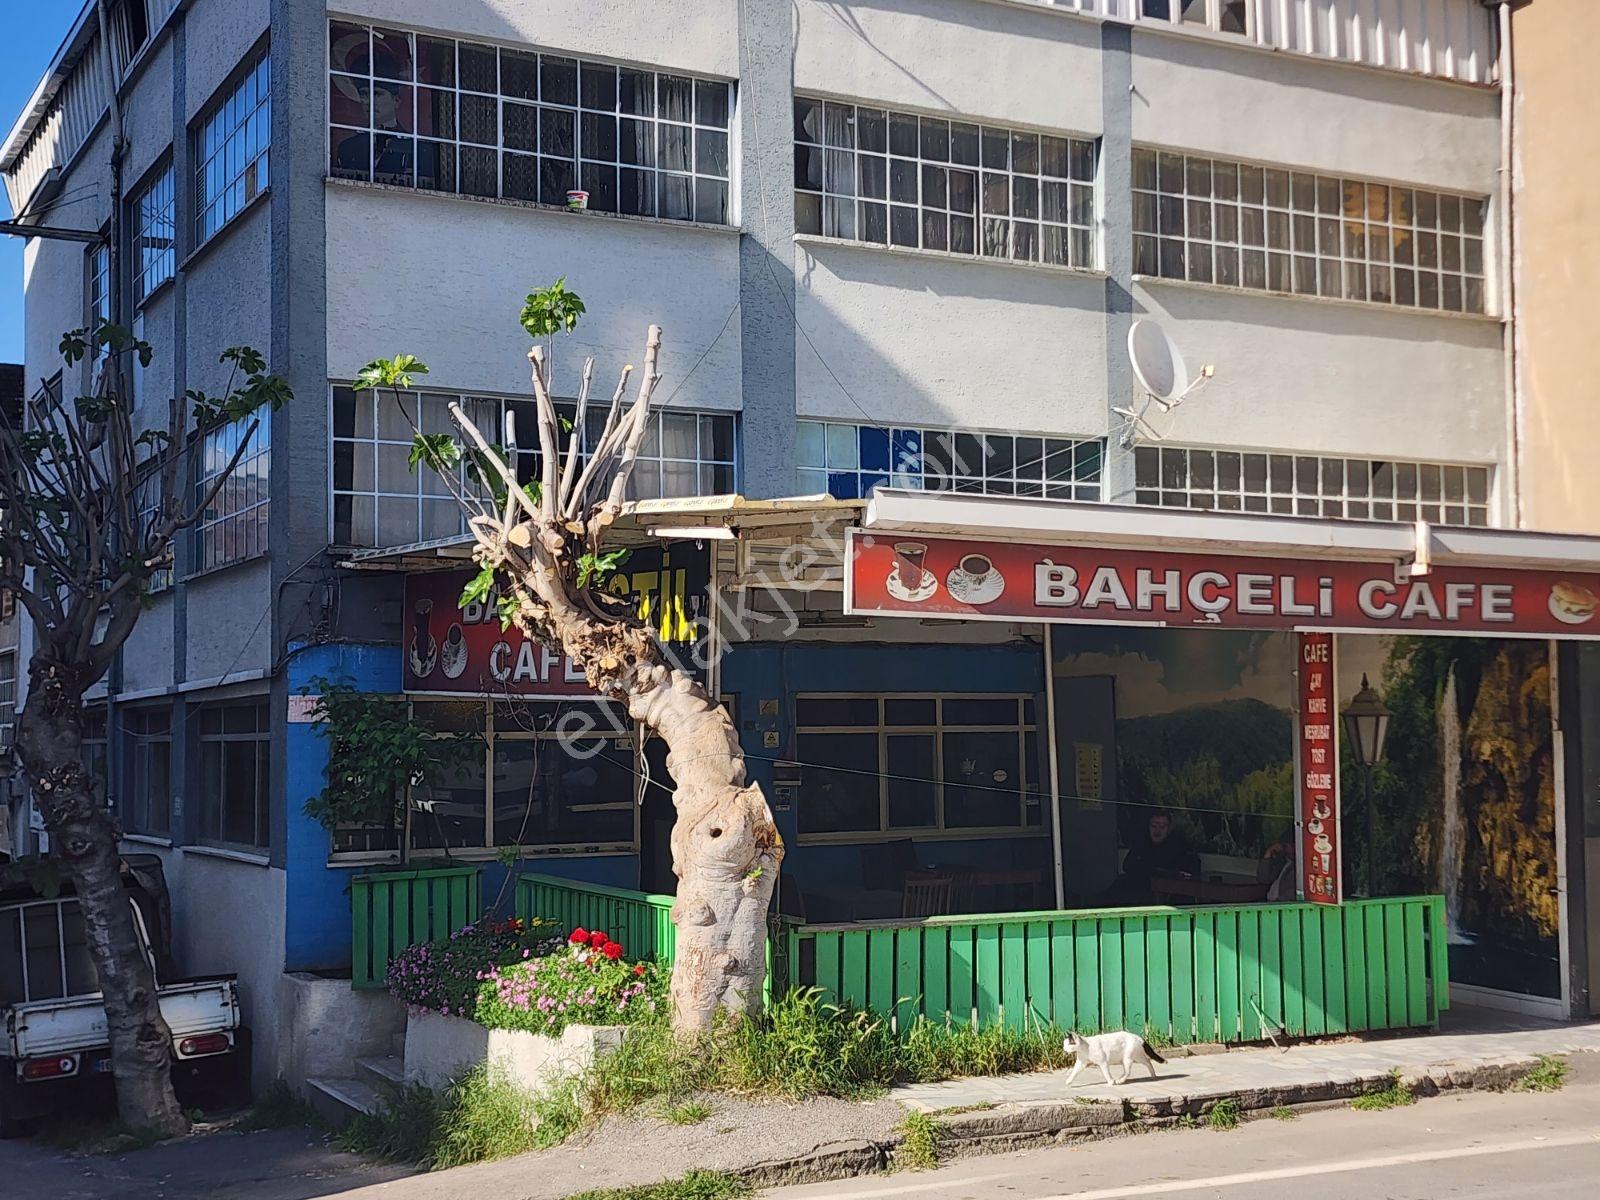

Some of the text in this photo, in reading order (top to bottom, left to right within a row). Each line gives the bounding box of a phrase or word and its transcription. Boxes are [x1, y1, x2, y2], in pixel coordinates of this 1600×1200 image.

[1358, 578, 1515, 622] CAFE
[1304, 643, 1328, 663] CAFE
[1311, 748, 1325, 764] TOST
